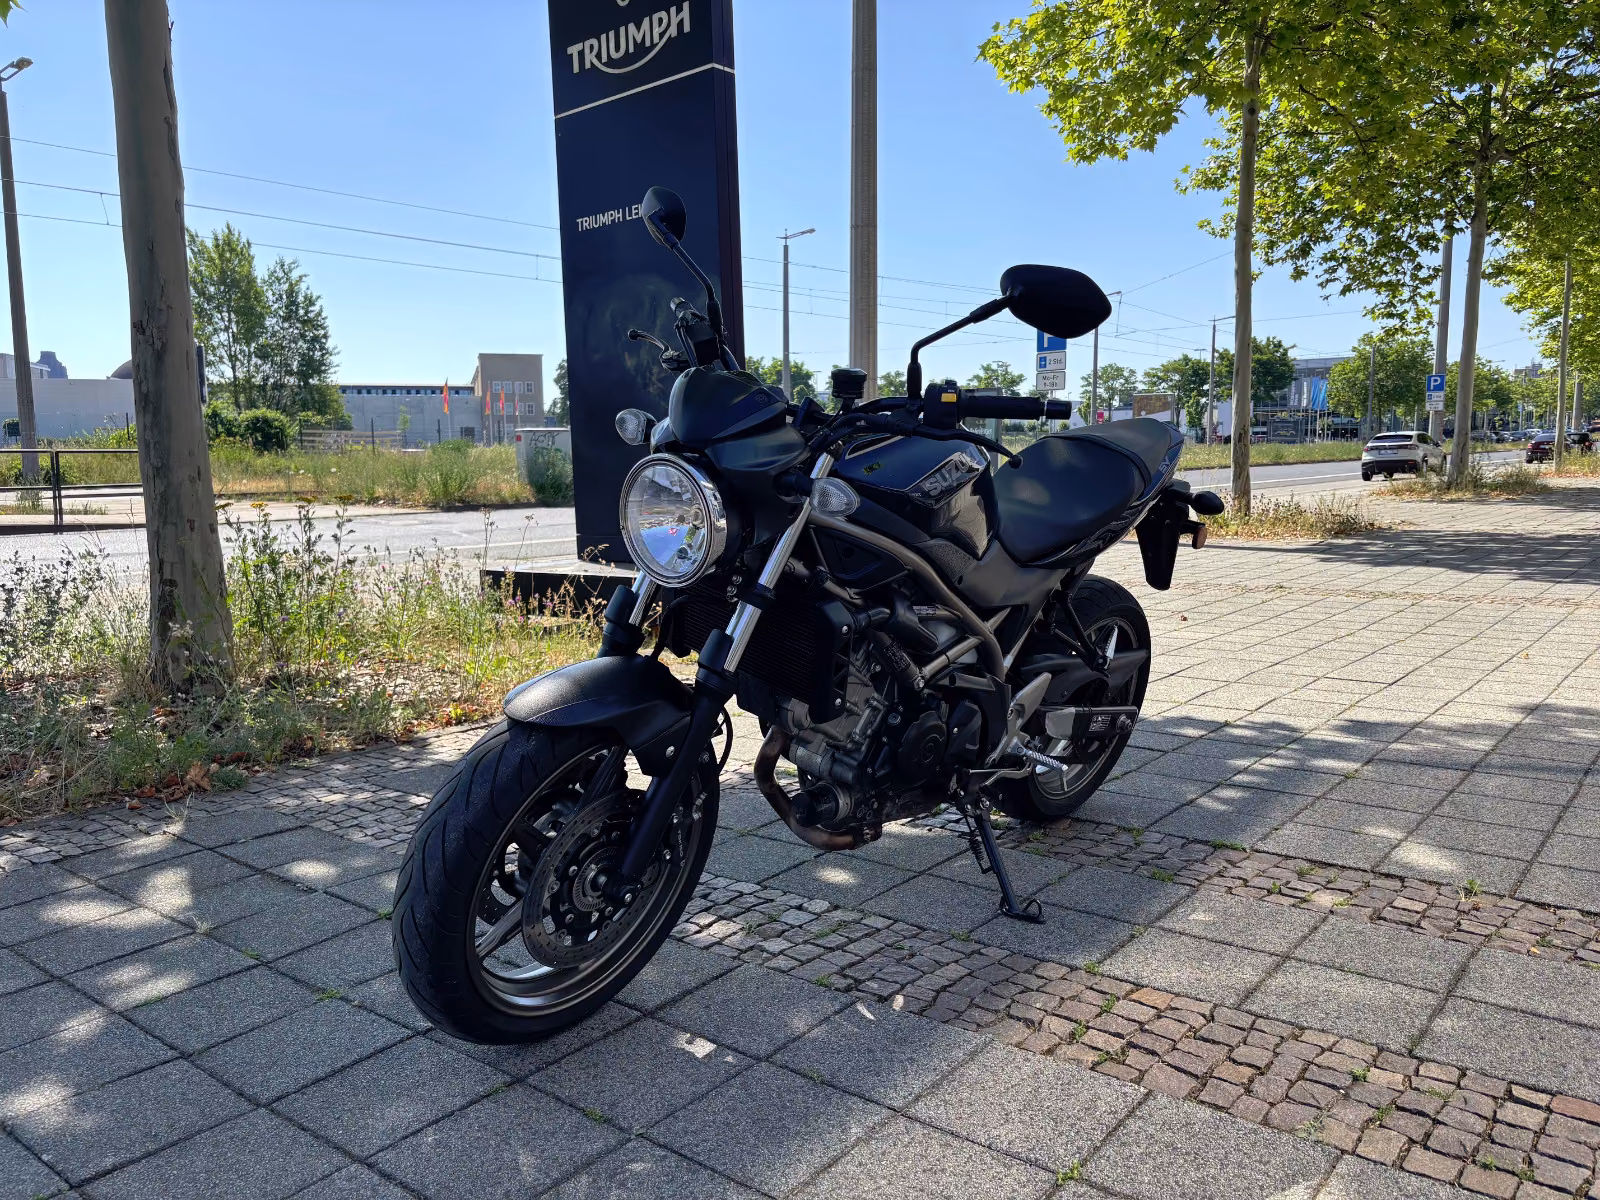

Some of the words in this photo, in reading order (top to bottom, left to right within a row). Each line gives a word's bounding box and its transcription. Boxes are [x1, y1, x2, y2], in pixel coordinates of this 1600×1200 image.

[566, 1, 691, 74] TRIUMPH
[576, 208, 623, 232] TRIUMPH
[625, 203, 642, 220] LEI
[1430, 376, 1441, 390] P
[924, 453, 970, 496] SUZU
